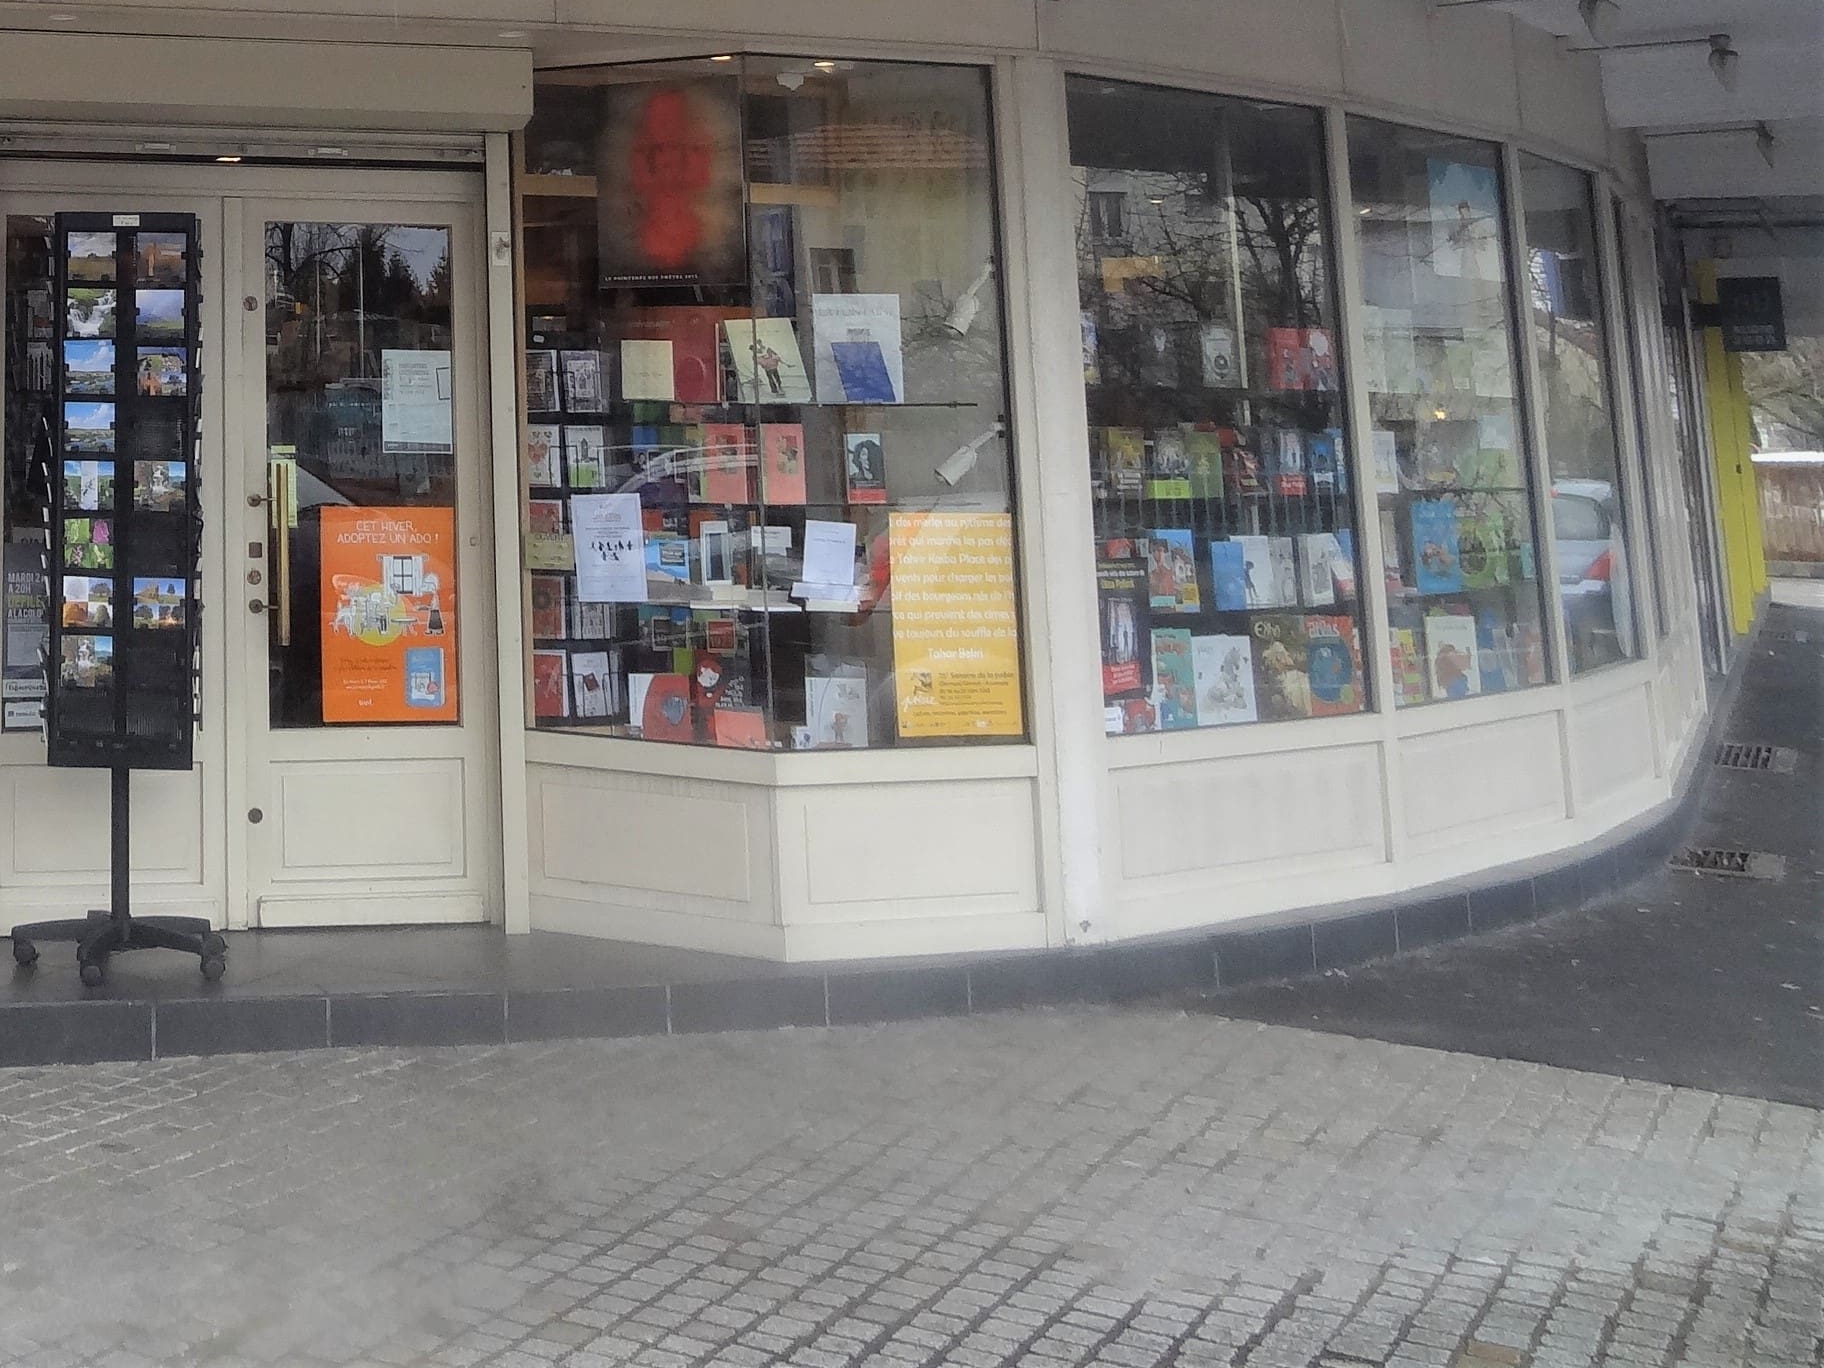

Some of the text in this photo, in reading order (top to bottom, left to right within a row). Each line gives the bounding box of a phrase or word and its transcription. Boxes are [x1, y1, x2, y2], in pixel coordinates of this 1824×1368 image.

[356, 520, 417, 532] CET HIVER,
[336, 533, 385, 544] ADOPTEZ
[389, 533, 406, 544] UN
[409, 533, 431, 544] ADO
[7, 572, 34, 583] MARDI
[15, 583, 31, 594] 20H
